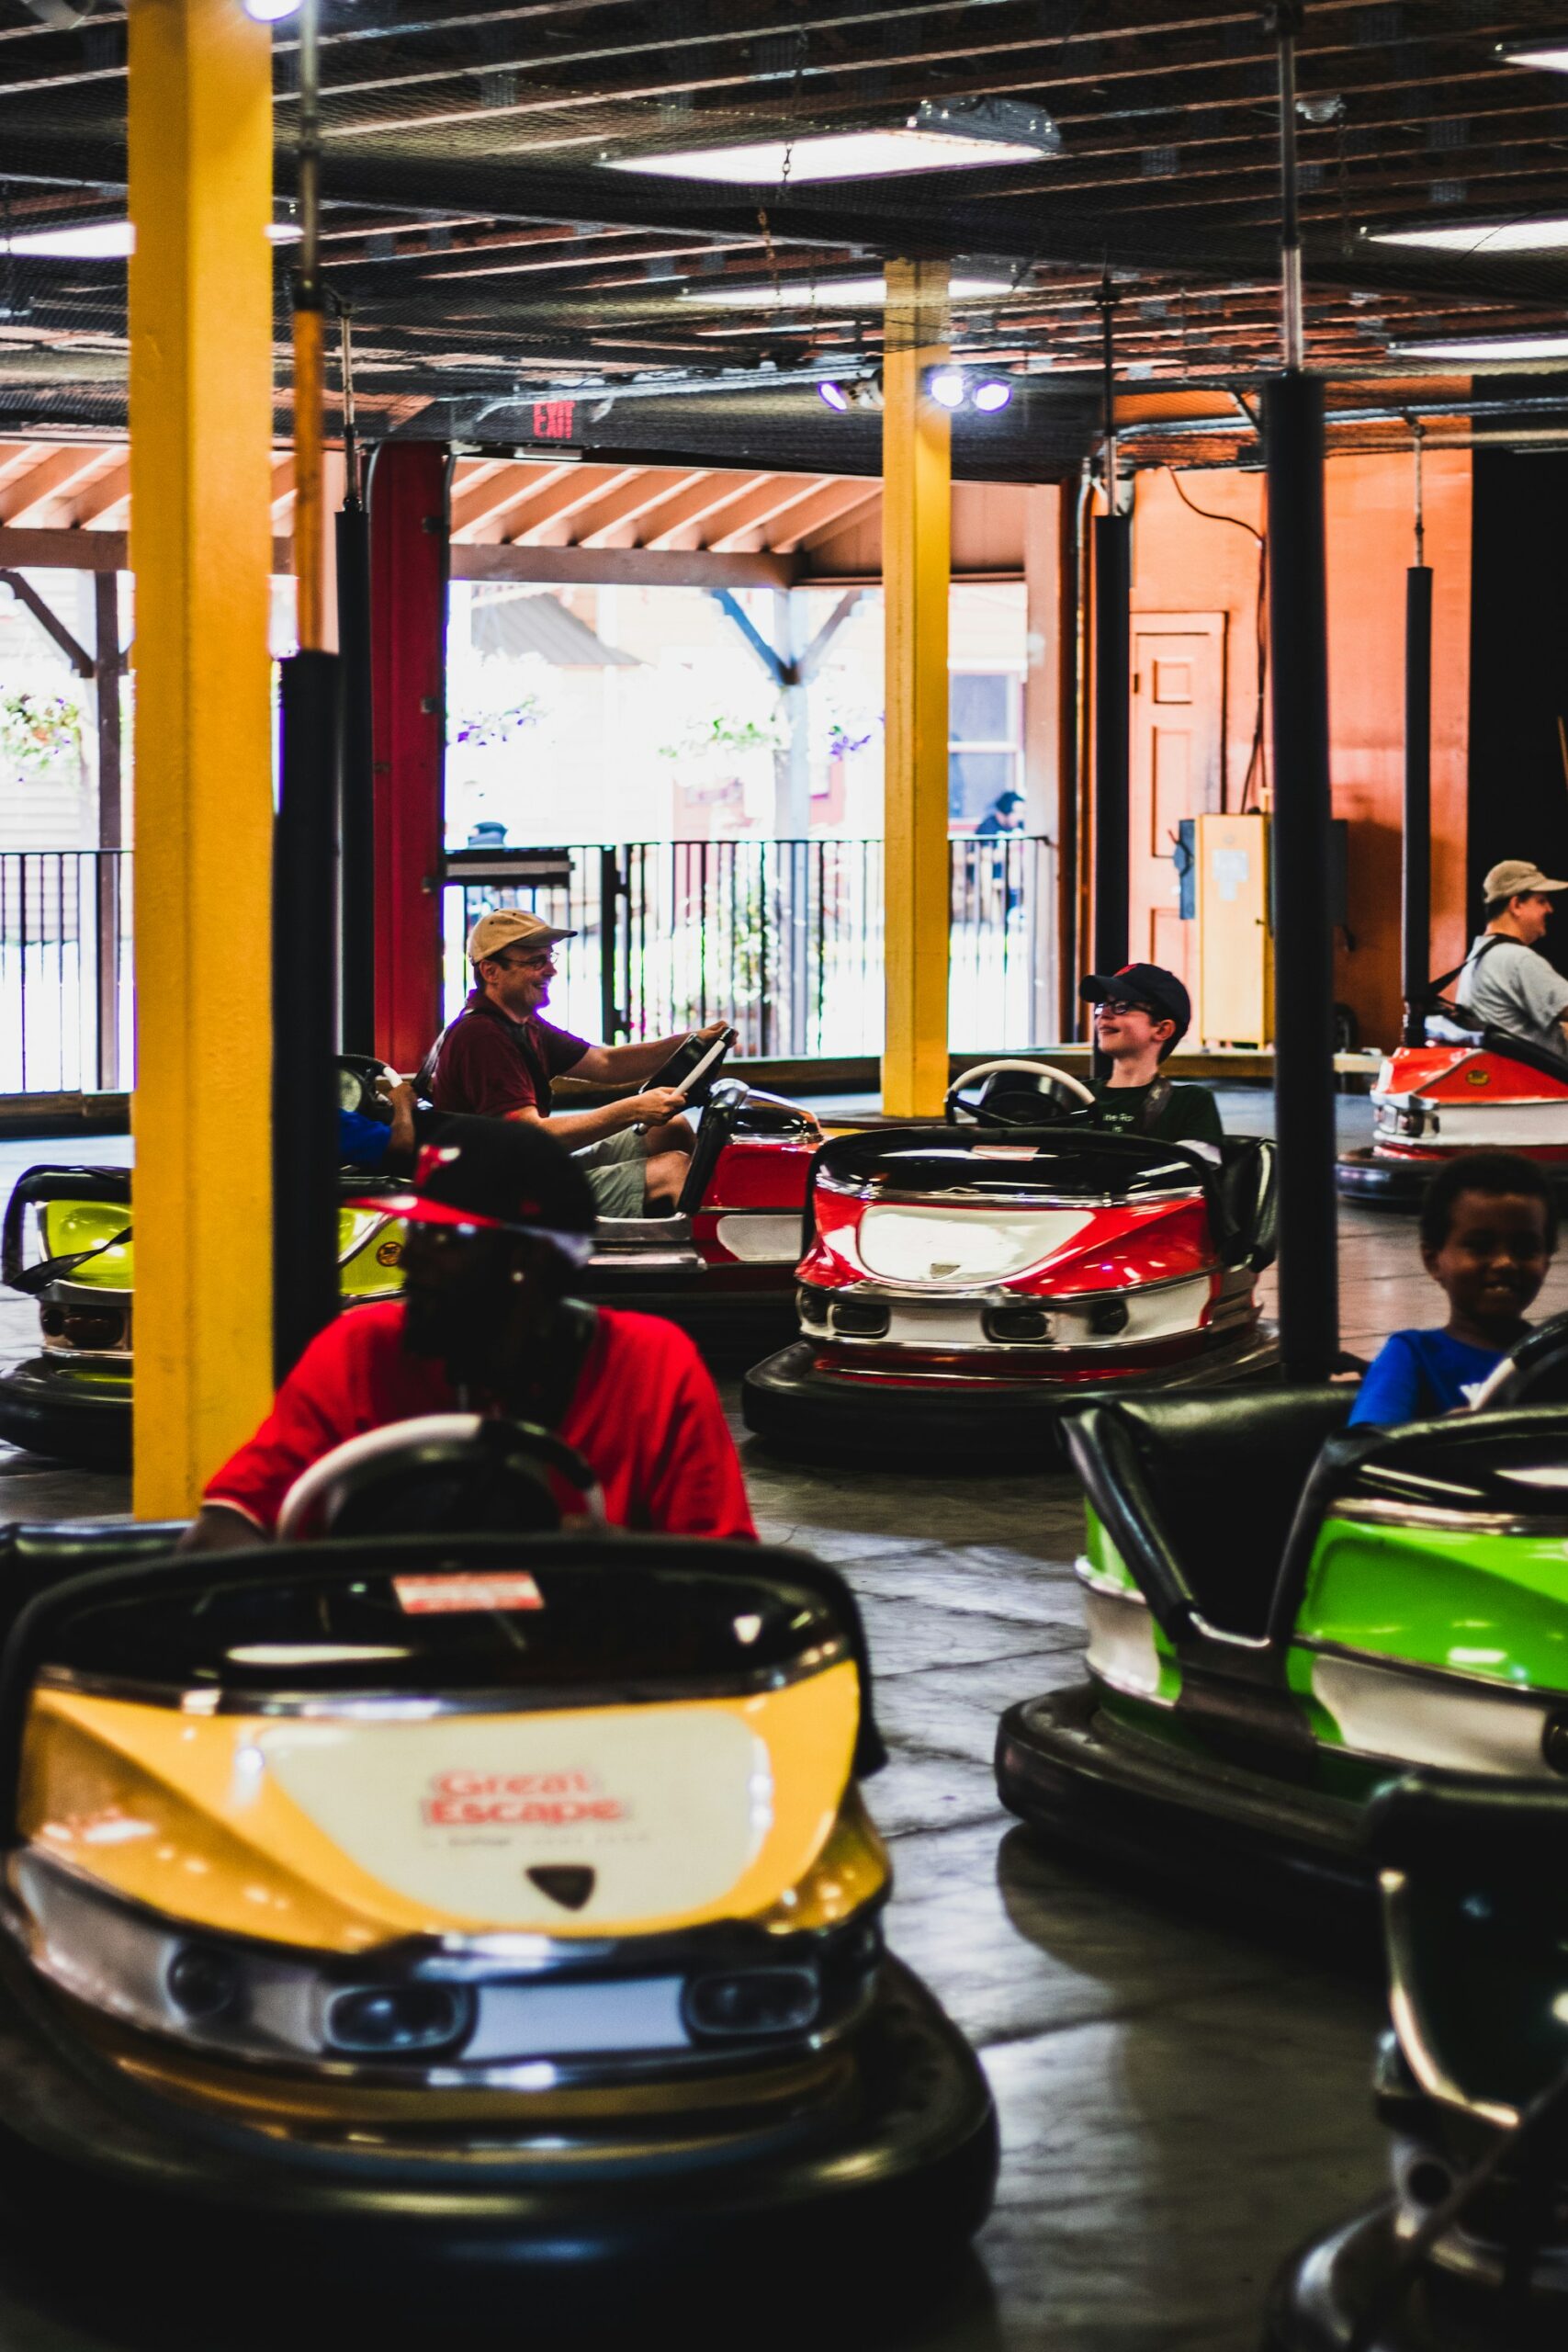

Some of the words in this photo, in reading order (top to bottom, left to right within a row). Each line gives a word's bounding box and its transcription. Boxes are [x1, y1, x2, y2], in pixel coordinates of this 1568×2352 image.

[533, 401, 575, 438] EXIT
[433, 1770, 593, 1794] Great
[423, 1797, 628, 1826] Escape
